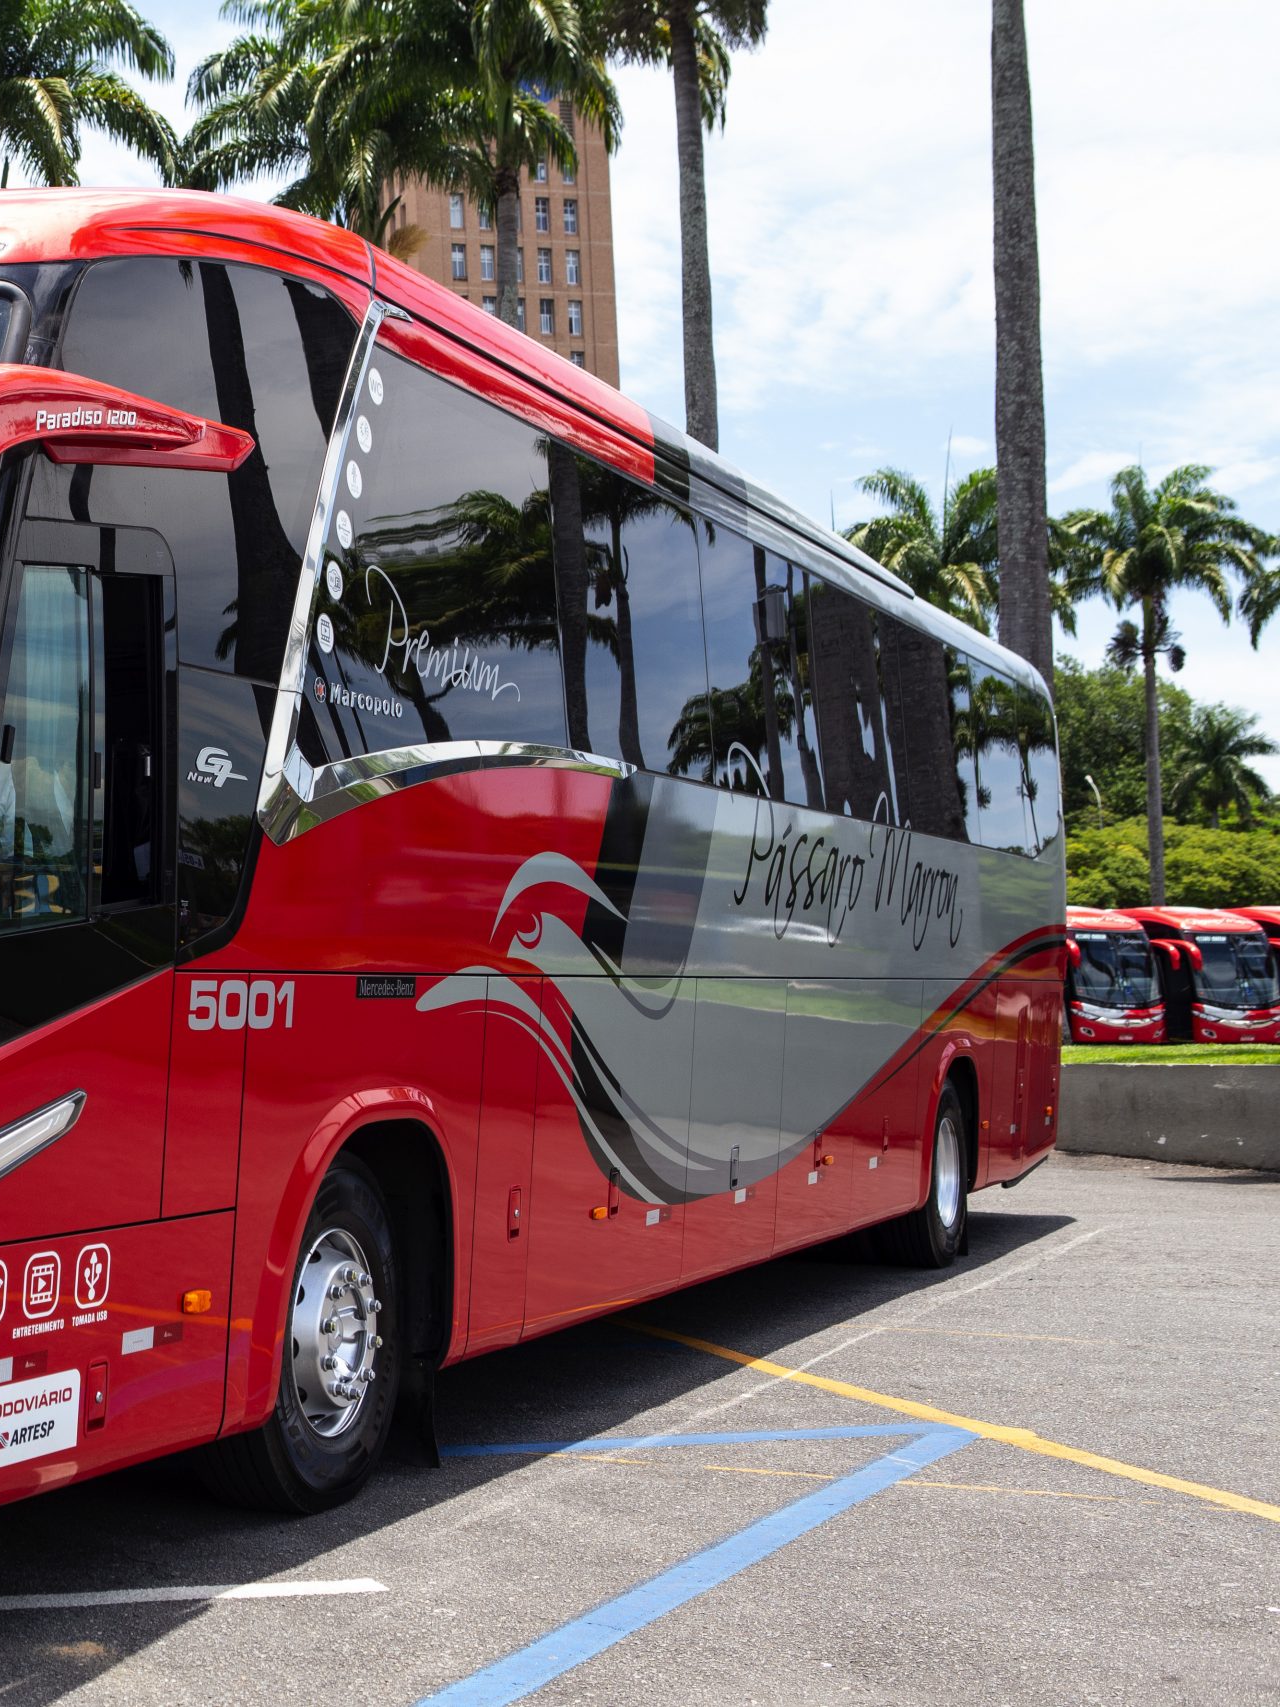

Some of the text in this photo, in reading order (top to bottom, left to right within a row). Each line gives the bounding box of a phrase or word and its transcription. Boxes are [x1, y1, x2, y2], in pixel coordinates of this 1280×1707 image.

[369, 377, 382, 397] WC
[35, 406, 137, 431] Paradiso 1200
[365, 565, 520, 702] Premium
[329, 682, 403, 718] Marcopolo
[186, 771, 213, 784] New
[727, 741, 963, 951] Pássaro Marron
[358, 979, 415, 997] Mercedes-Benz
[188, 979, 296, 1031] 5001
[12, 1318, 65, 1339] ENTRETENIMENTO
[71, 1310, 108, 1327] TOMADA USB
[9, 1419, 55, 1447] ARTESP
